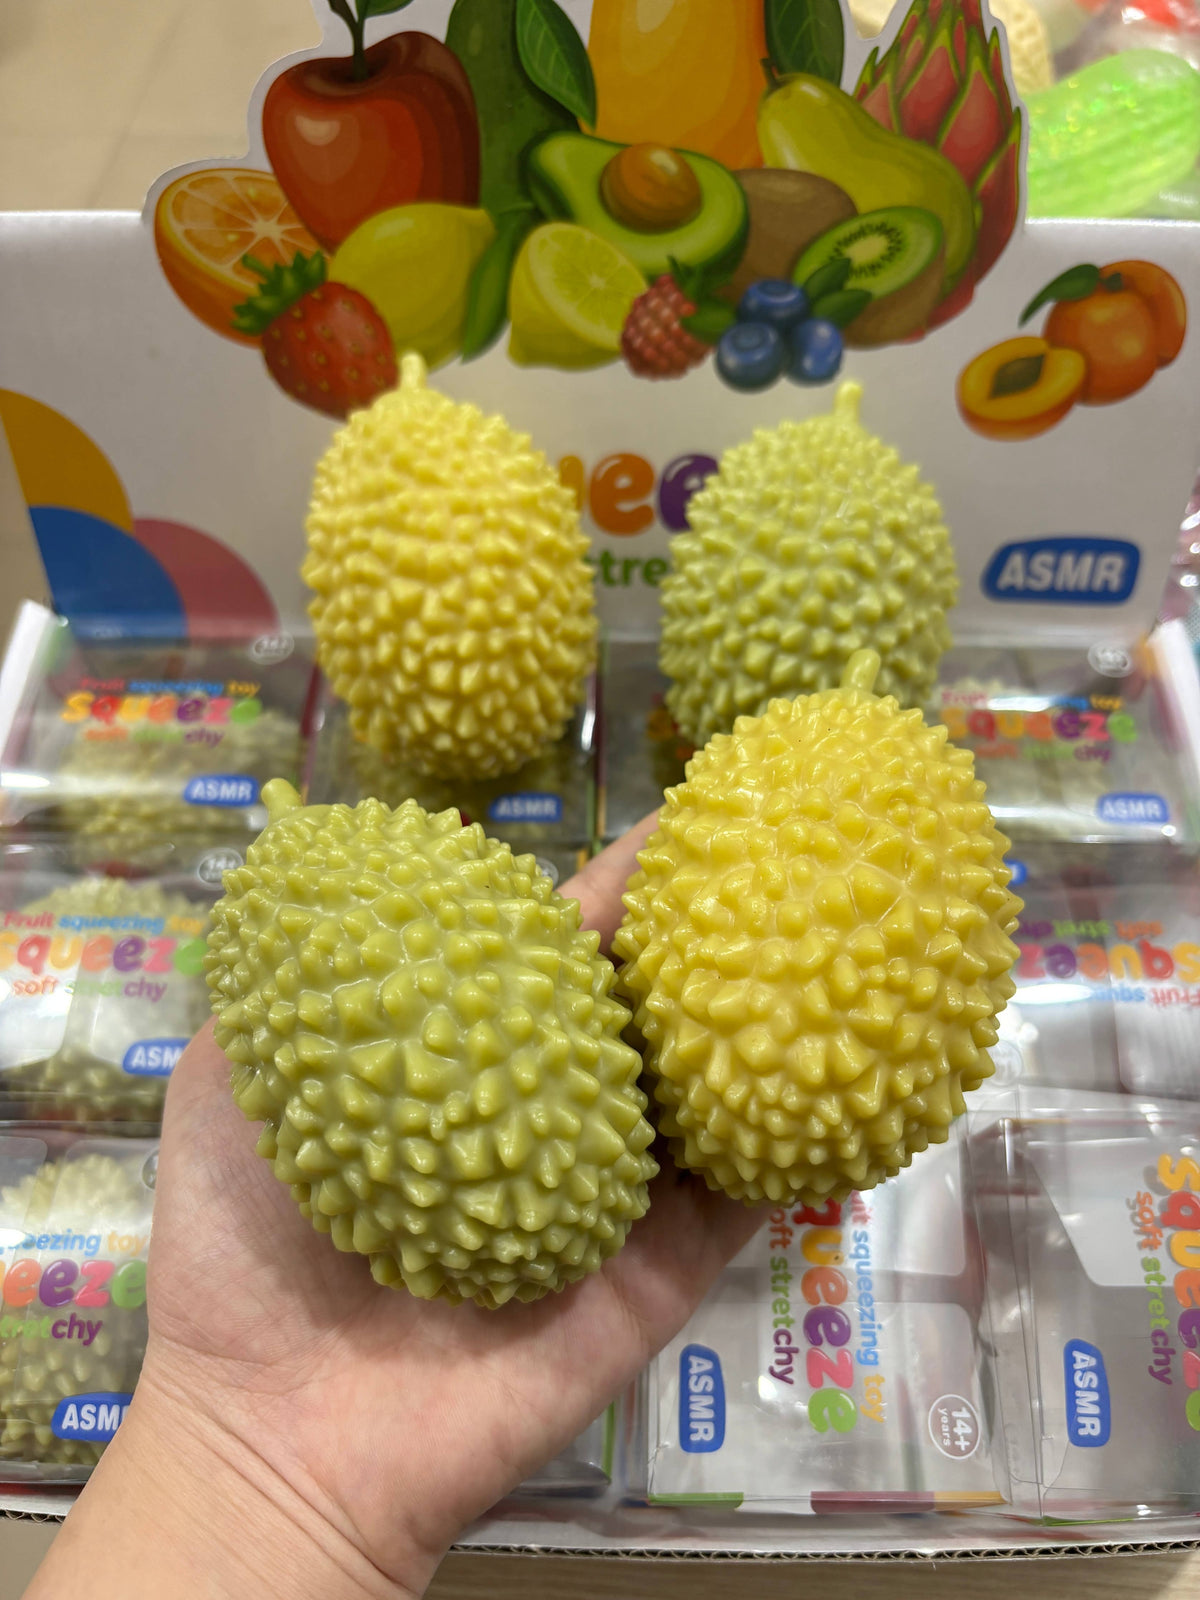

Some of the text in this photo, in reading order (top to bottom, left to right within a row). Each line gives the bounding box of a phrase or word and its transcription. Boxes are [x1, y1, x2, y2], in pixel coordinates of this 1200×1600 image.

[997, 553, 1127, 591] ASMR
[60, 691, 262, 726] squeeze
[940, 707, 1137, 743] squeeze
[191, 779, 253, 800] ASMR
[495, 796, 557, 818] ASMR
[1103, 803, 1162, 820] ASMR
[4, 912, 55, 928] Fruit
[59, 913, 165, 935] squeezing
[1015, 938, 1200, 983] squeez
[12, 975, 59, 996] soft
[131, 1046, 184, 1070] ASM
[107, 1230, 150, 1258] toy
[0, 1258, 148, 1309] eeze
[768, 1207, 799, 1385] oft stretchy
[849, 1230, 882, 1367] squeezing
[1136, 1191, 1176, 1386] soft stretchy
[0, 1312, 103, 1346] tretchy
[793, 1196, 858, 1434] queeze
[688, 1355, 715, 1442] ASMR
[860, 1374, 887, 1423] toy
[1072, 1350, 1101, 1437] ASMR
[61, 1403, 130, 1431] ASM
[937, 1407, 951, 1446] years
[951, 1407, 971, 1451] 14+
